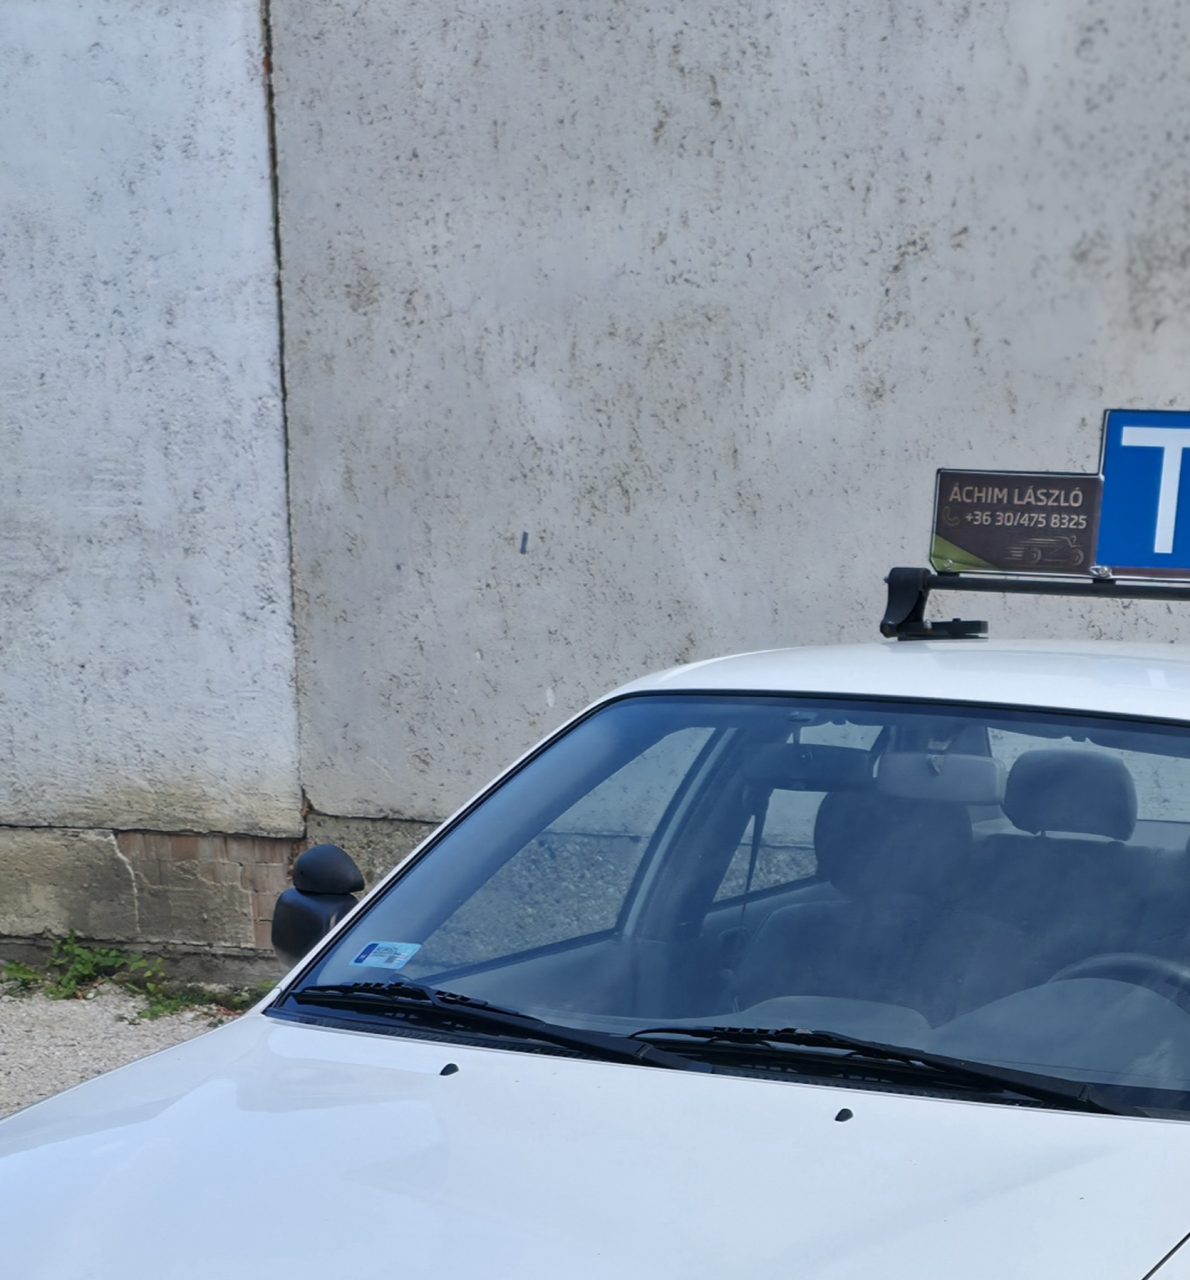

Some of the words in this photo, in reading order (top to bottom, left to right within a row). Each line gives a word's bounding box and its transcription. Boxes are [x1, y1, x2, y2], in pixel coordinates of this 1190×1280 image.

[949, 483, 1008, 504] ÁCHIM
[1013, 486, 1083, 507] LÁSZLÓ
[965, 511, 992, 525] +36
[995, 512, 1047, 527] 30/475
[1050, 514, 1087, 529] 8325
